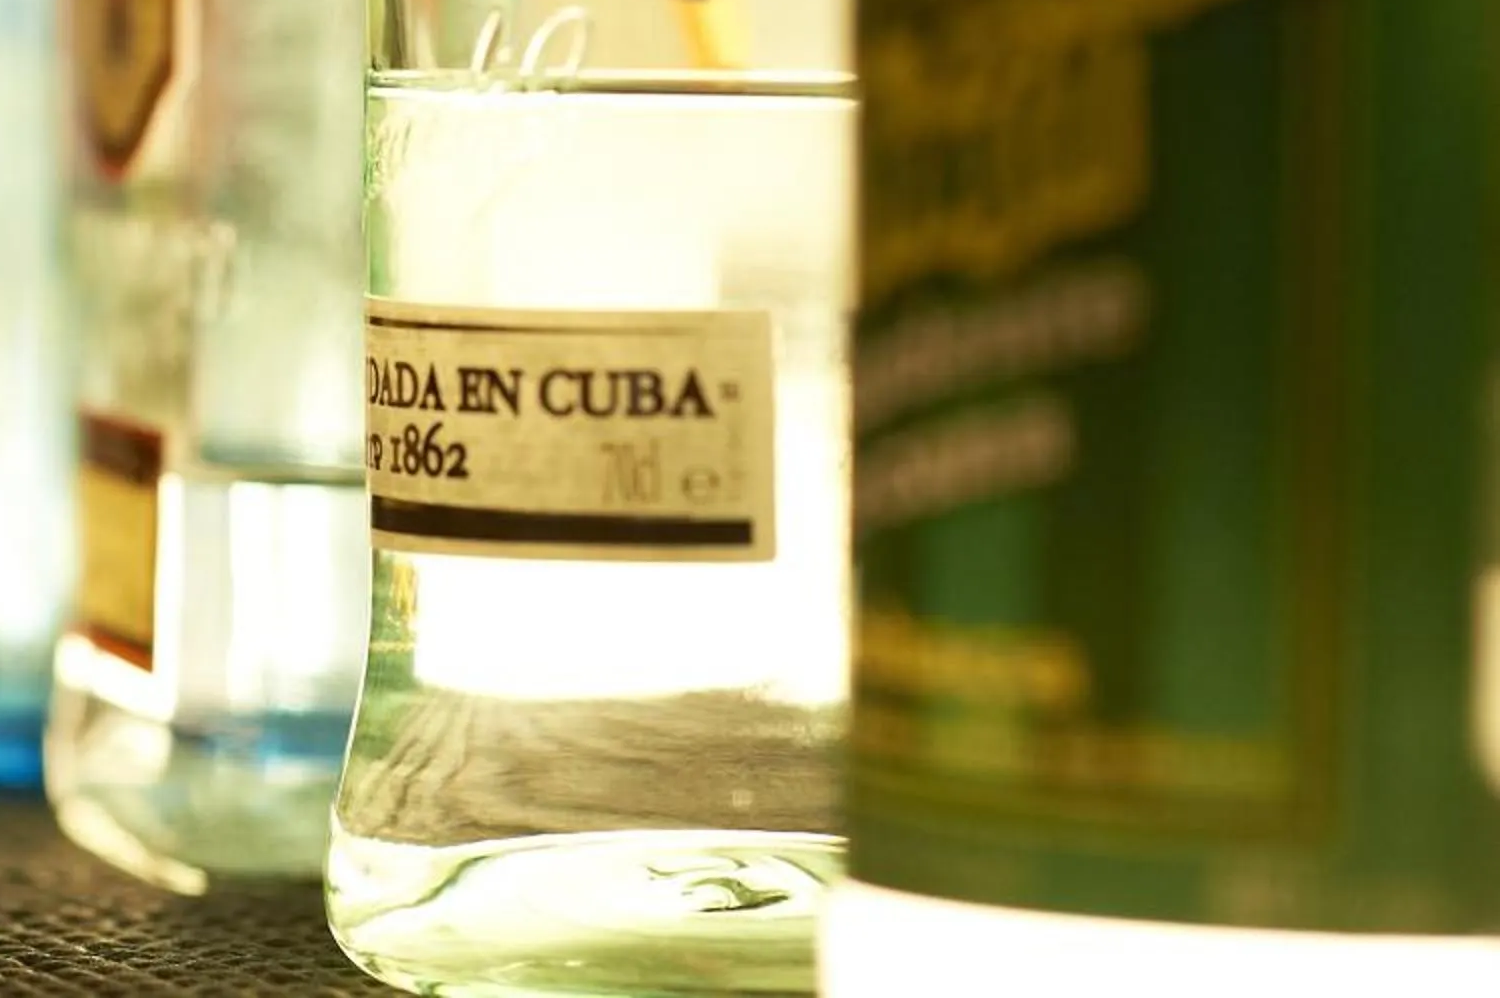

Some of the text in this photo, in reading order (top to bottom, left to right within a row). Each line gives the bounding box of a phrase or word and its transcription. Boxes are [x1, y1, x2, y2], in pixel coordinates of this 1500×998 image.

[457, 366, 525, 416] EN
[538, 366, 717, 419] CUBA
[389, 421, 470, 479] 1862
